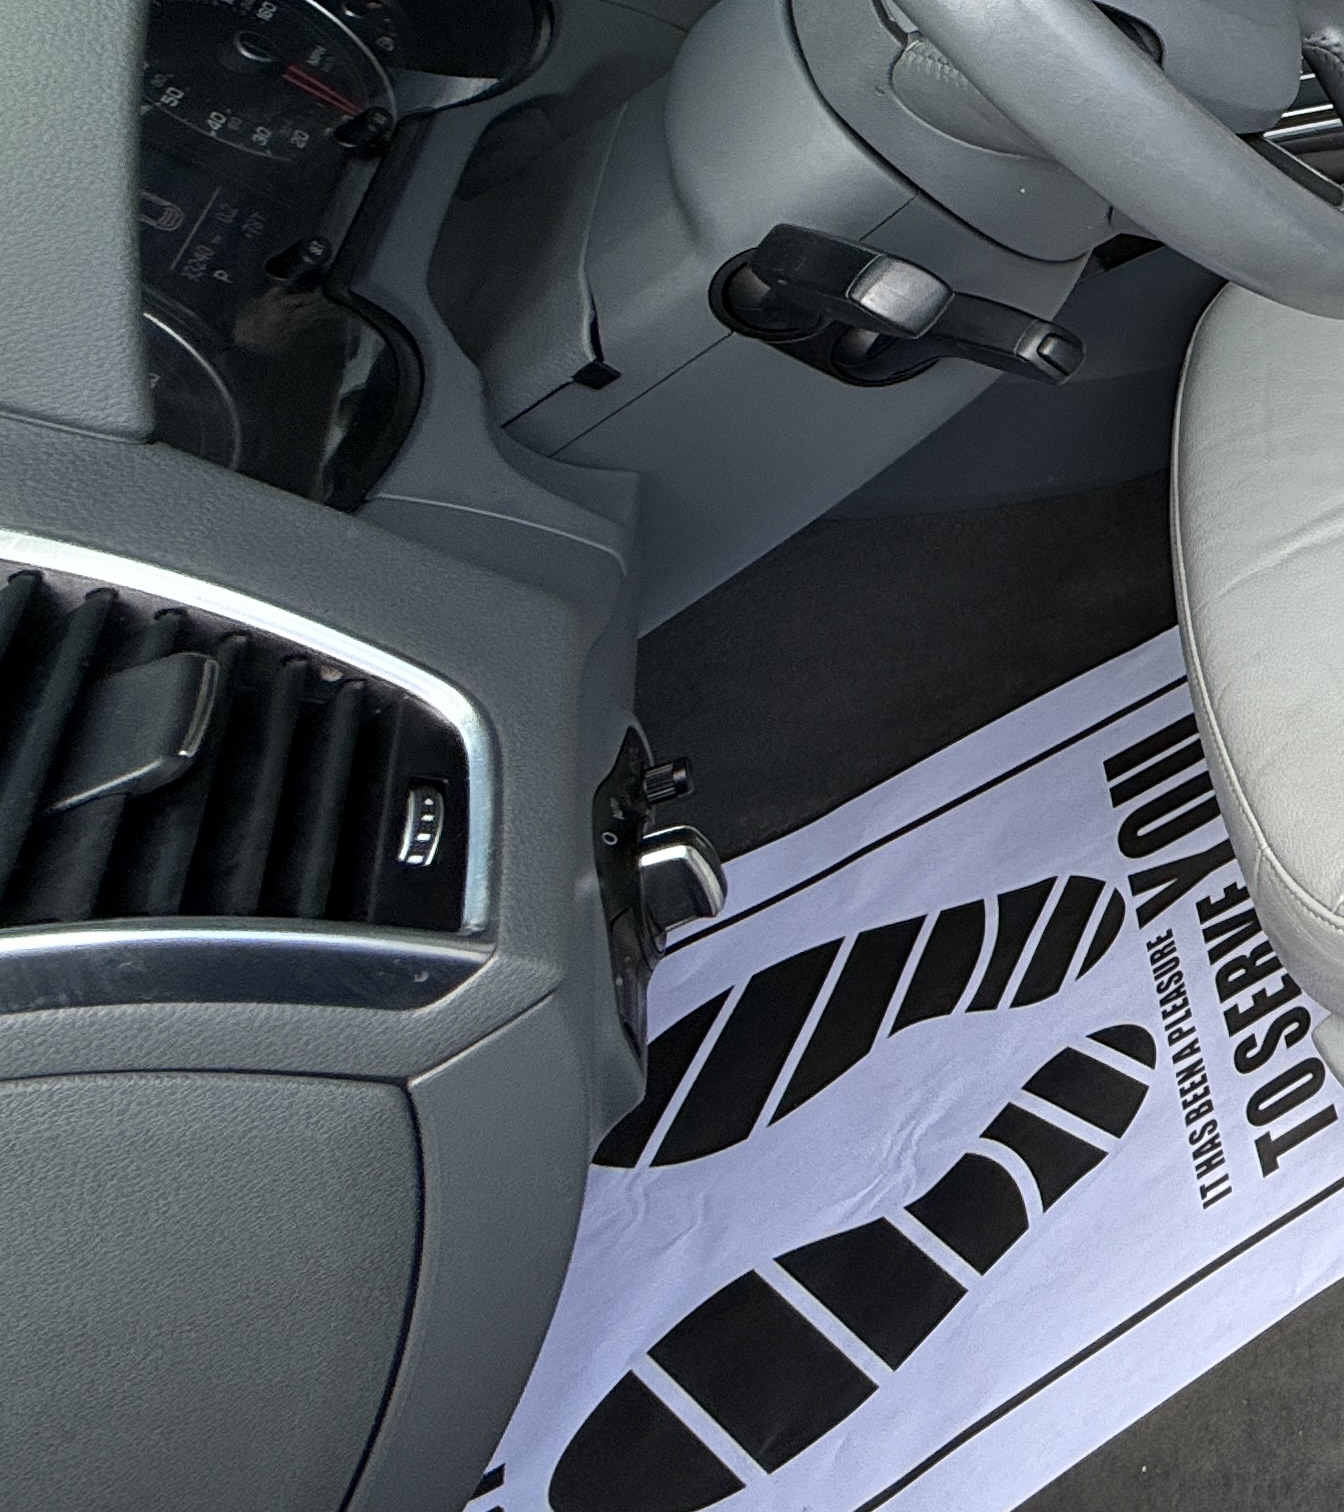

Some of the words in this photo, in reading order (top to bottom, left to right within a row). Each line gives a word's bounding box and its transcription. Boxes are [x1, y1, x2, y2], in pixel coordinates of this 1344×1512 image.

[159, 86, 185, 107] 50
[206, 110, 227, 132] 40
[251, 126, 271, 146] 30
[290, 129, 309, 148] 20
[1146, 927, 1197, 1047] PLEASURE
[1196, 881, 1312, 1075] SERVE
[1171, 1037, 1202, 1065] A
[1175, 1057, 1215, 1128] BEEN
[1246, 1056, 1339, 1178] TO
[1187, 1118, 1226, 1181] HAS
[1199, 1172, 1233, 1210] IT
